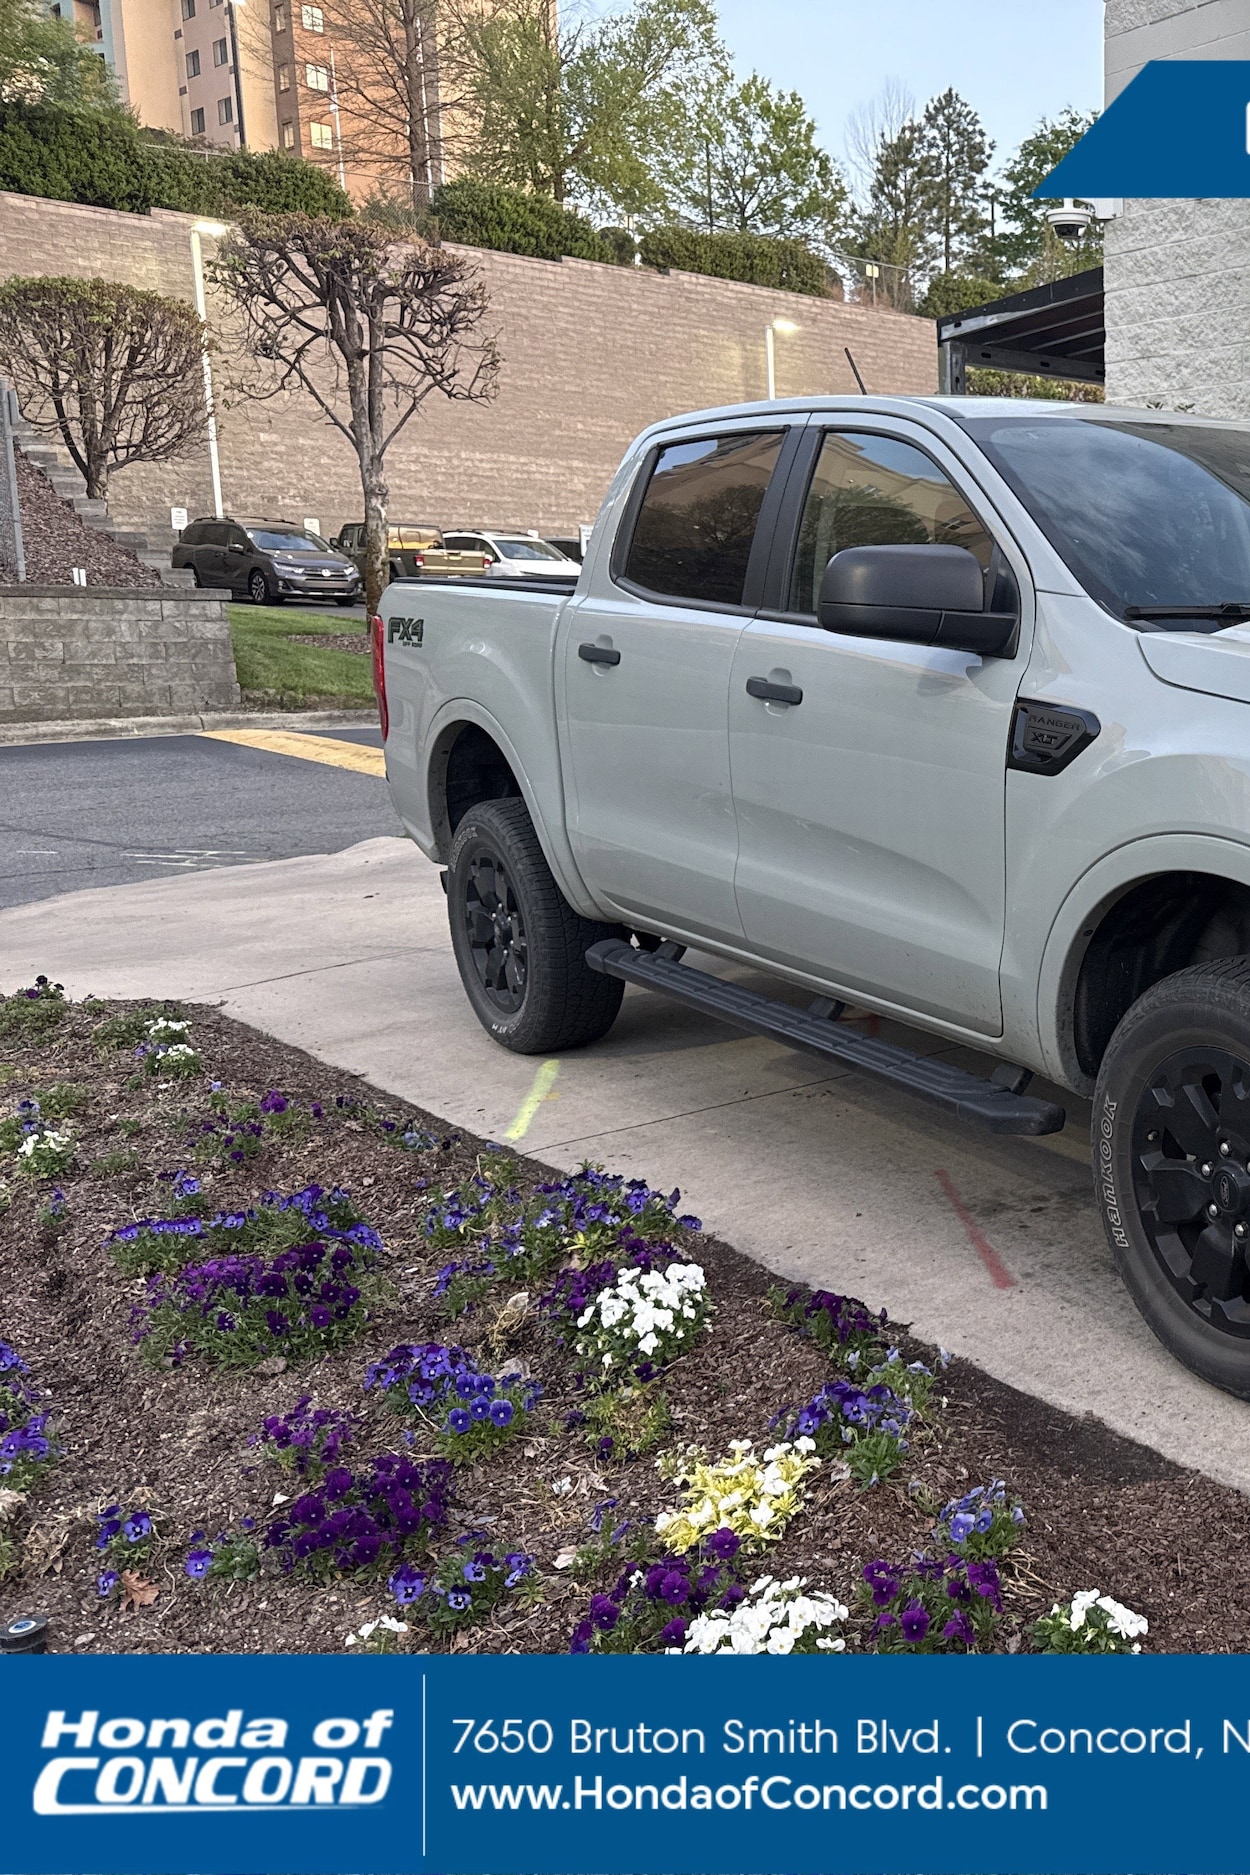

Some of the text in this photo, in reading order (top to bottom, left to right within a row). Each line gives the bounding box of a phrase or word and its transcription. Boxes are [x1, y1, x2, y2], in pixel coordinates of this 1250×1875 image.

[388, 616, 424, 644] FX4
[1028, 714, 1081, 731] RANGER
[1031, 731, 1058, 745] XLT
[1099, 1091, 1129, 1248] Hankook
